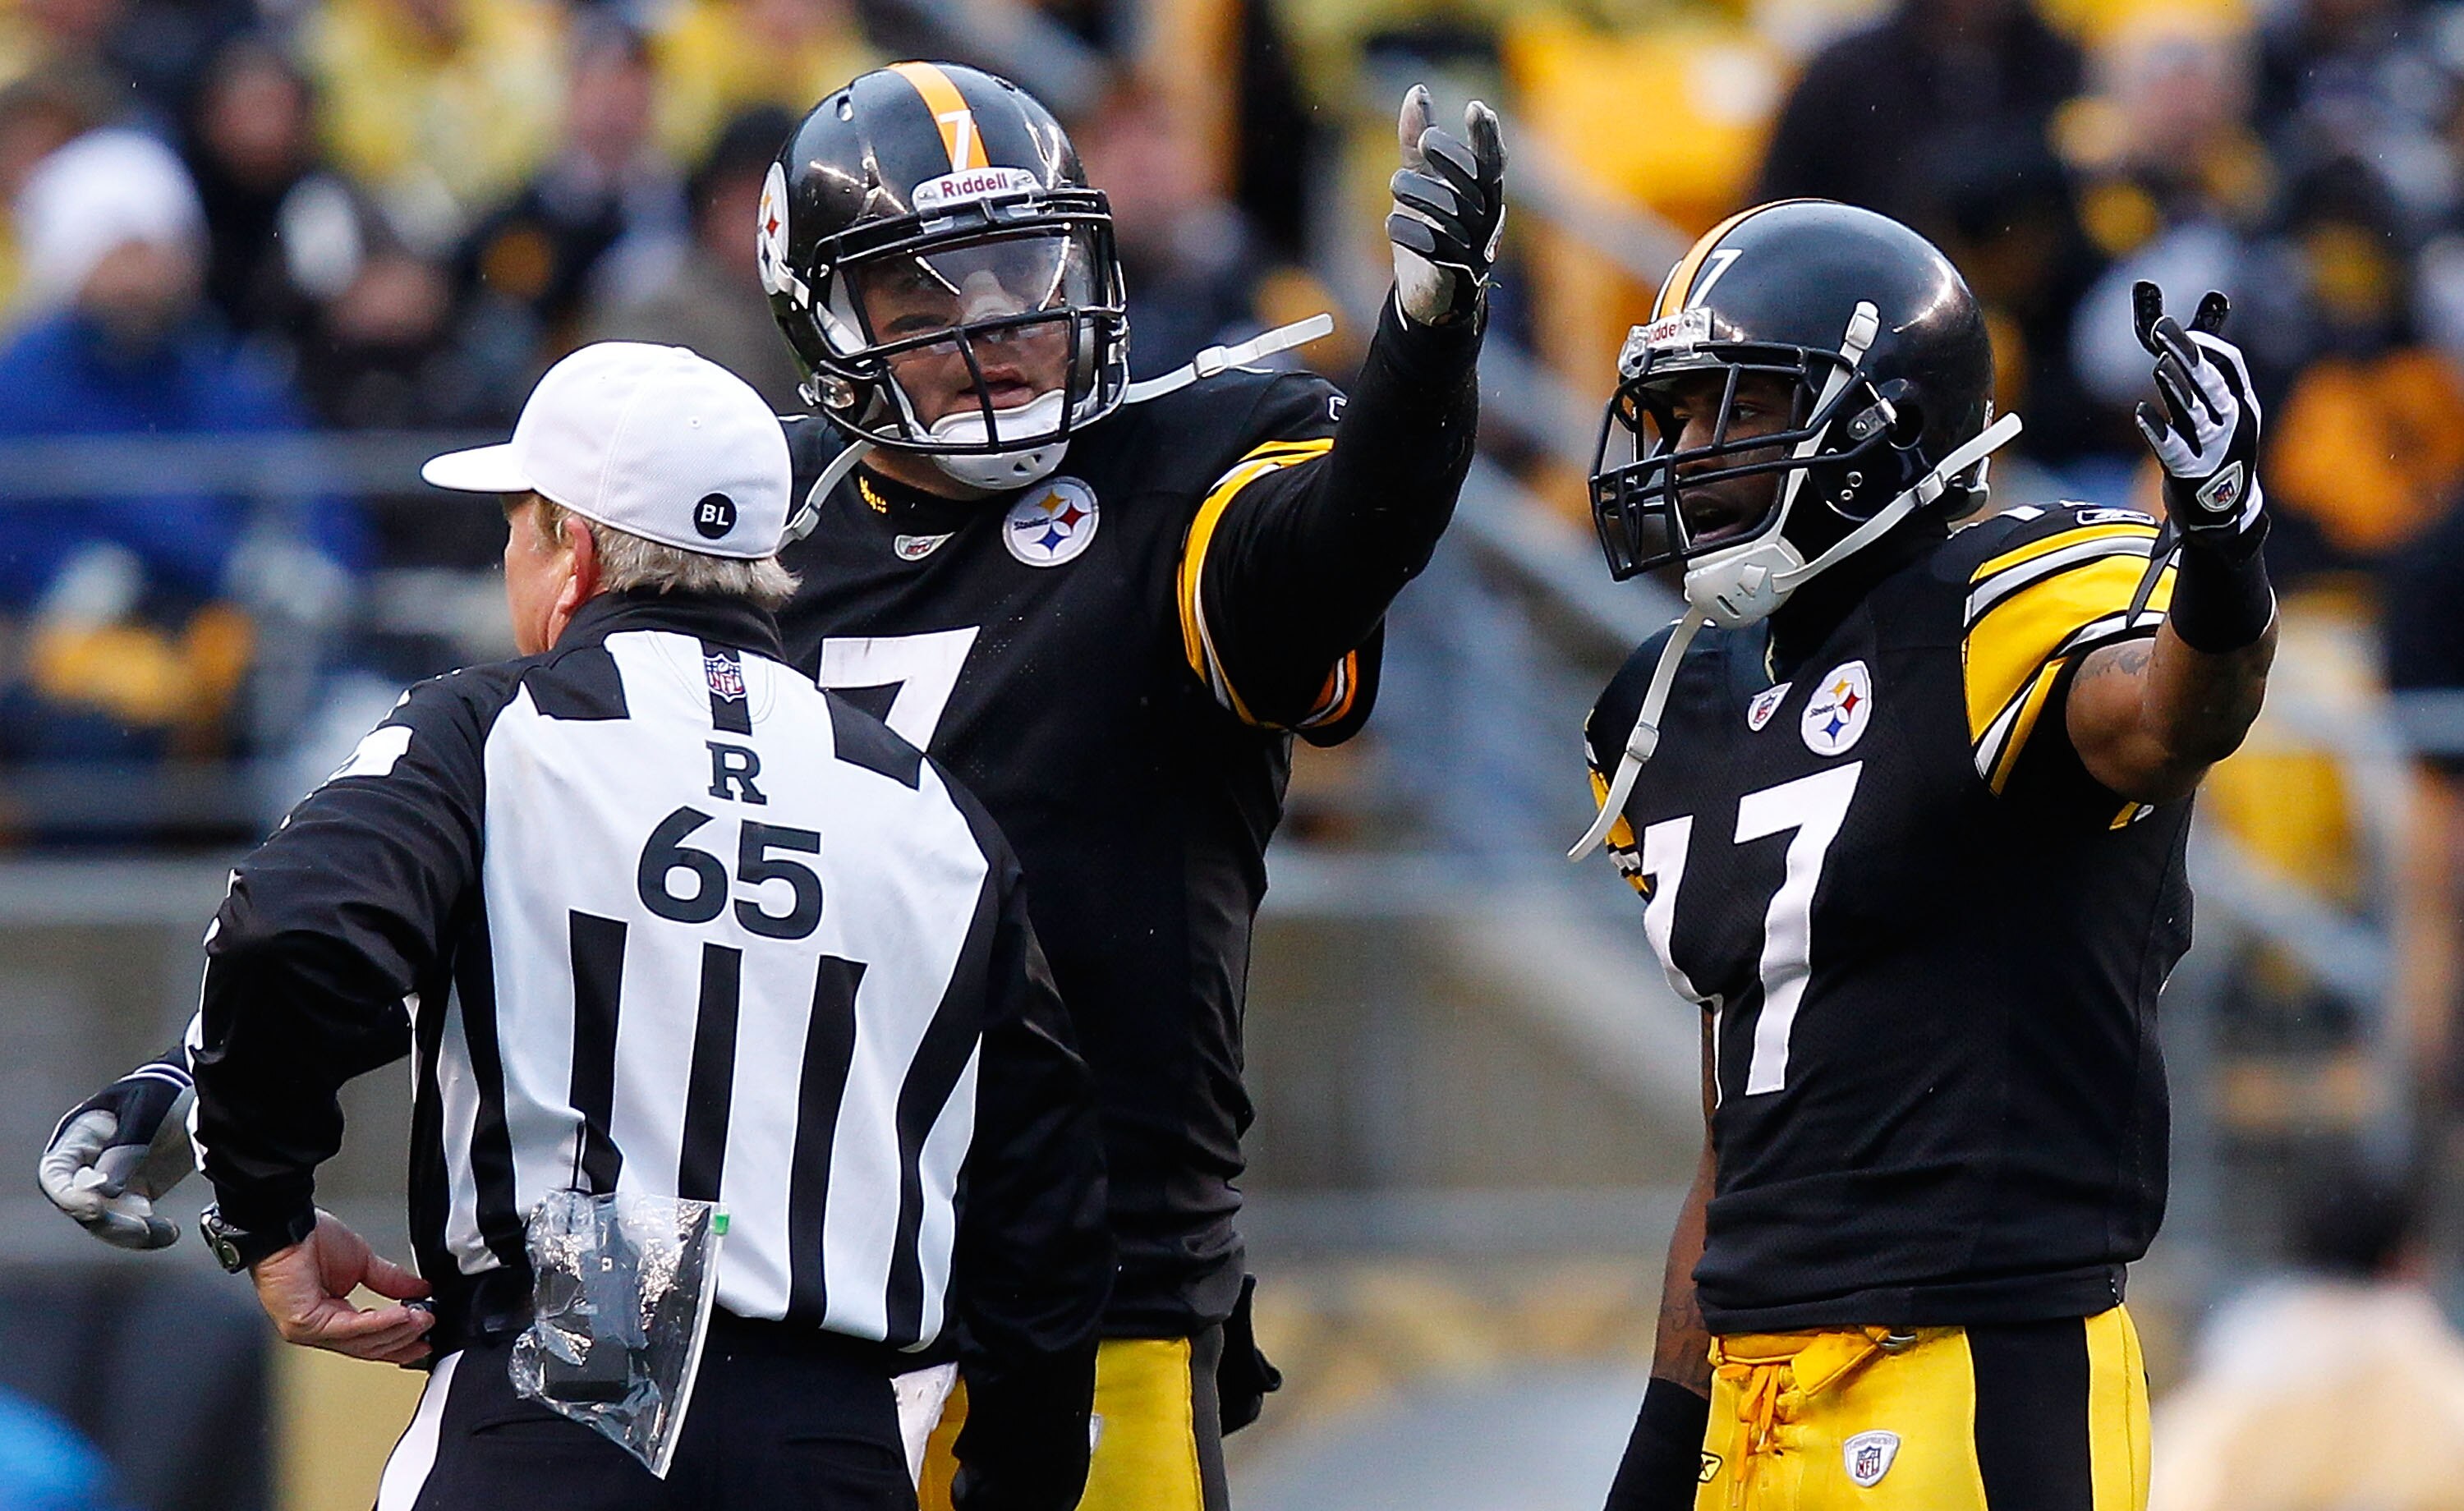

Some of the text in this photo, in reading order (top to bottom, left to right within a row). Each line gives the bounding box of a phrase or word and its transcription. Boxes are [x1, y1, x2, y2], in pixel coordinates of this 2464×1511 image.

[938, 109, 972, 172] 7
[940, 172, 1009, 198] Riddell
[701, 503, 729, 526] BL
[708, 672, 744, 694] NFL
[818, 625, 981, 755] 7
[706, 740, 767, 806] R
[638, 806, 821, 940] 65
[1643, 760, 1864, 1109] 17
[1857, 1458, 1879, 1477] NFL
